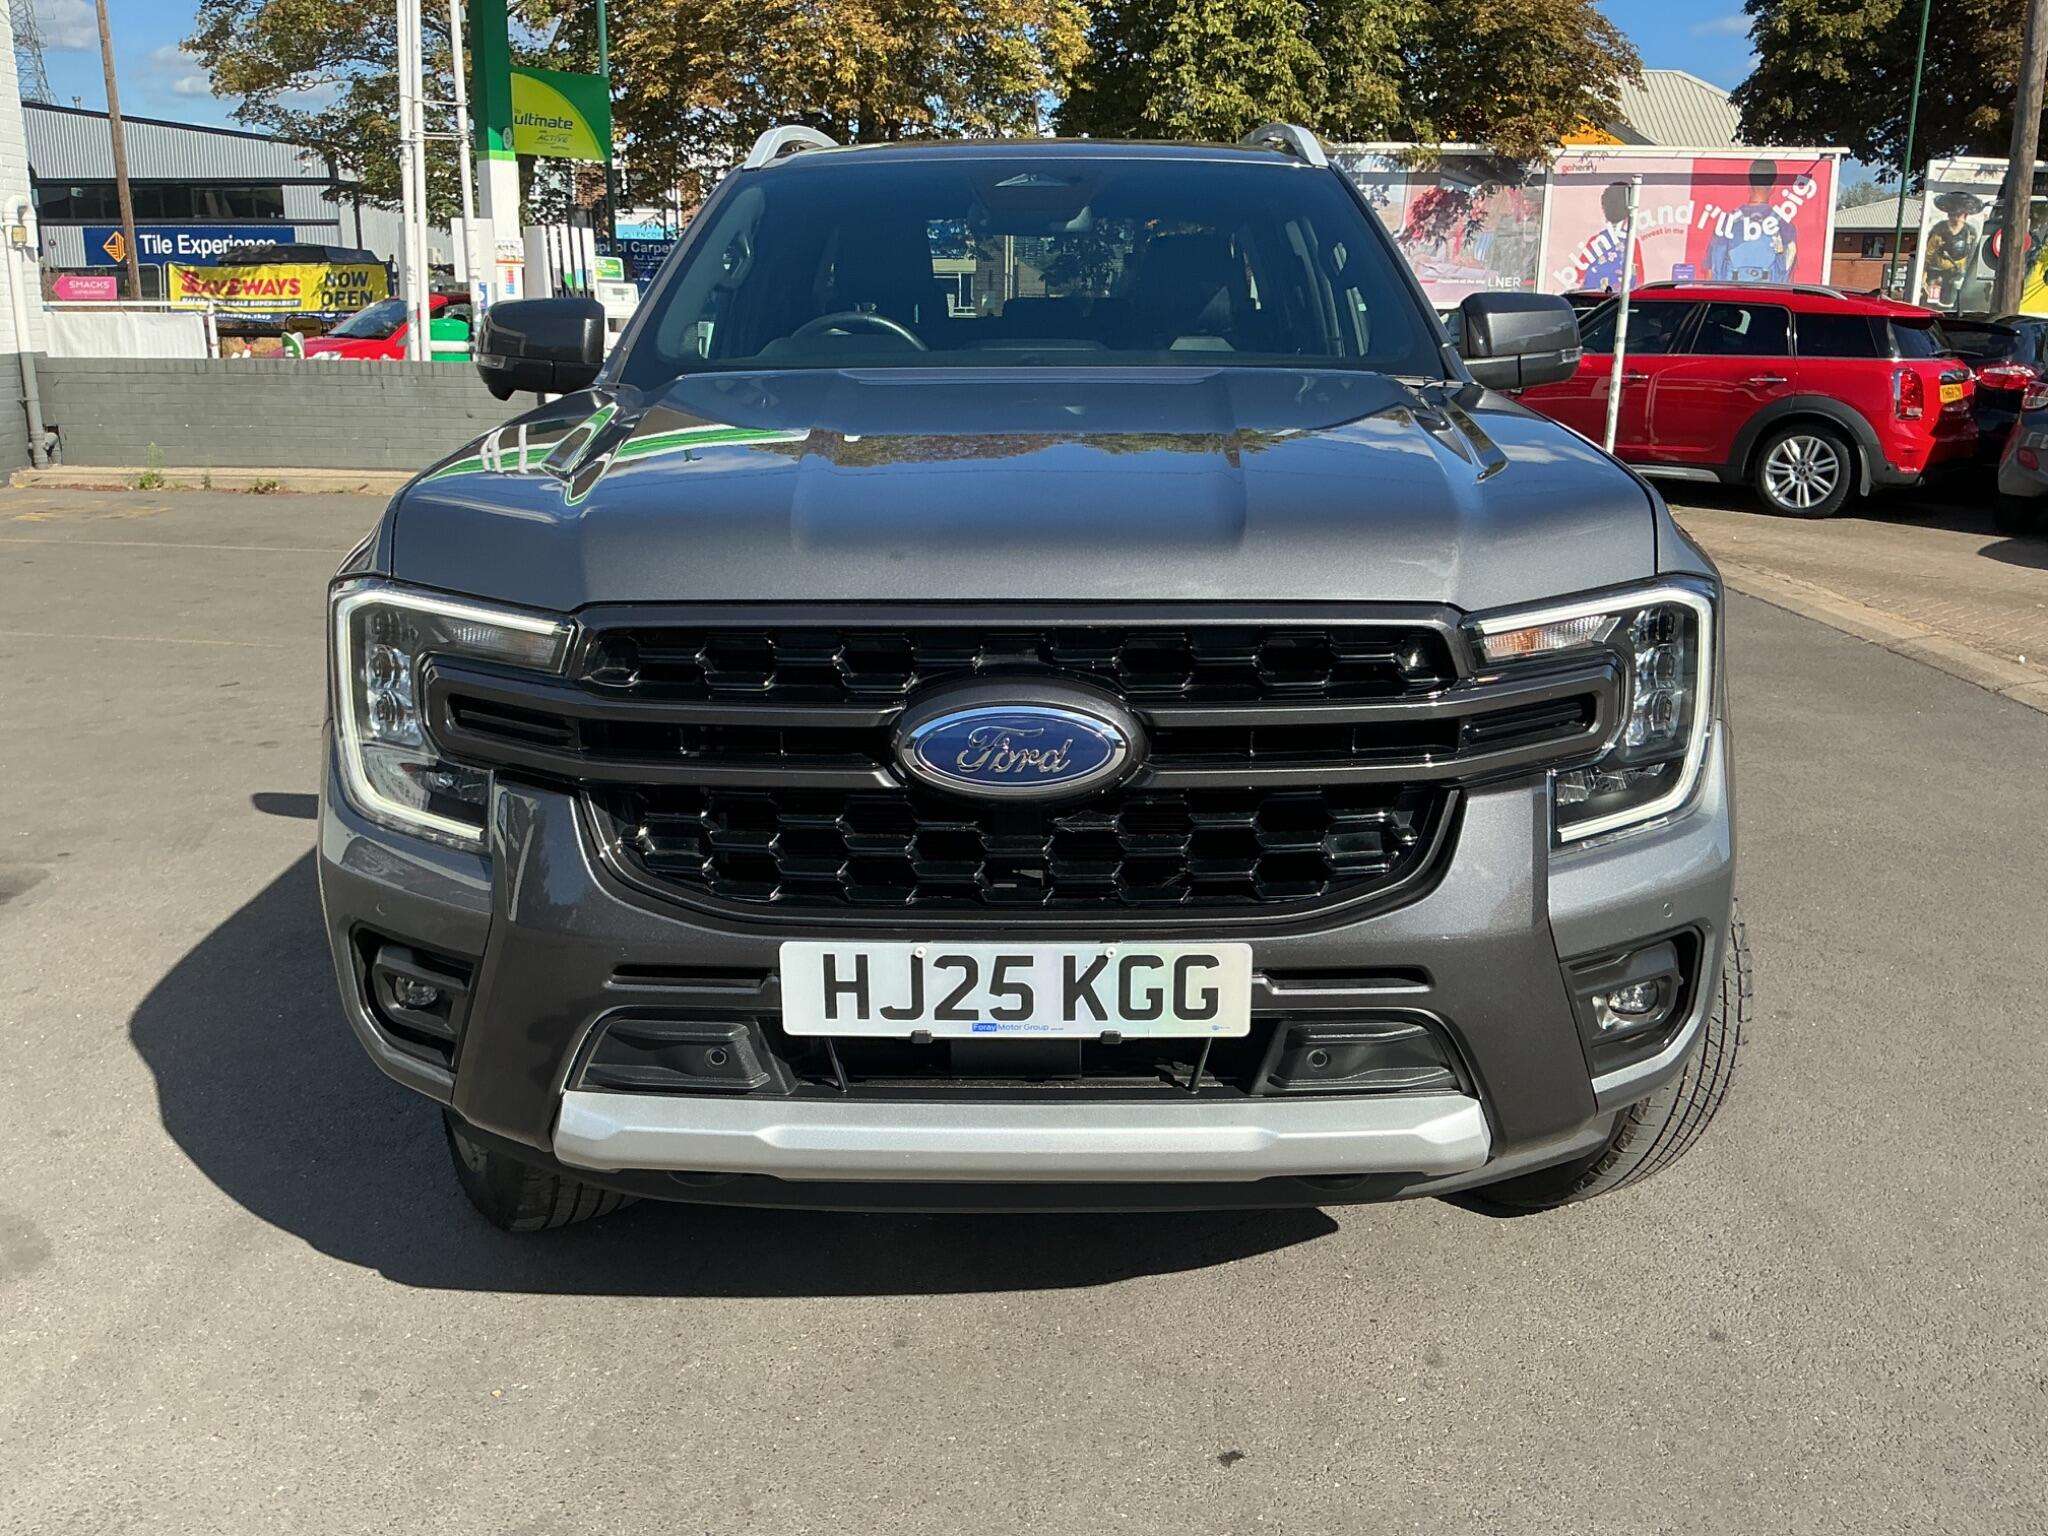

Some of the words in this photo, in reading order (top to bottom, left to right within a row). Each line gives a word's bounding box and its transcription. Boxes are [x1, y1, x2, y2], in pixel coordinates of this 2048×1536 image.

[1552, 219, 1628, 288] blink
[1637, 200, 1695, 228] and
[1697, 204, 1735, 239] i'll
[1743, 216, 1779, 242] be
[1772, 176, 1817, 224] big
[1641, 227, 1663, 241] invest
[139, 234, 173, 255] Tile
[324, 271, 369, 288] NOW
[1487, 276, 1521, 289] LNER
[321, 290, 373, 307] OPEN
[956, 725, 1074, 776] Ford
[821, 953, 1034, 1020] HJ25
[1062, 953, 1220, 1020] KGG
[973, 1024, 996, 1032] Foray
[998, 1023, 1020, 1031] Motor
[1023, 1023, 1049, 1033] Group
